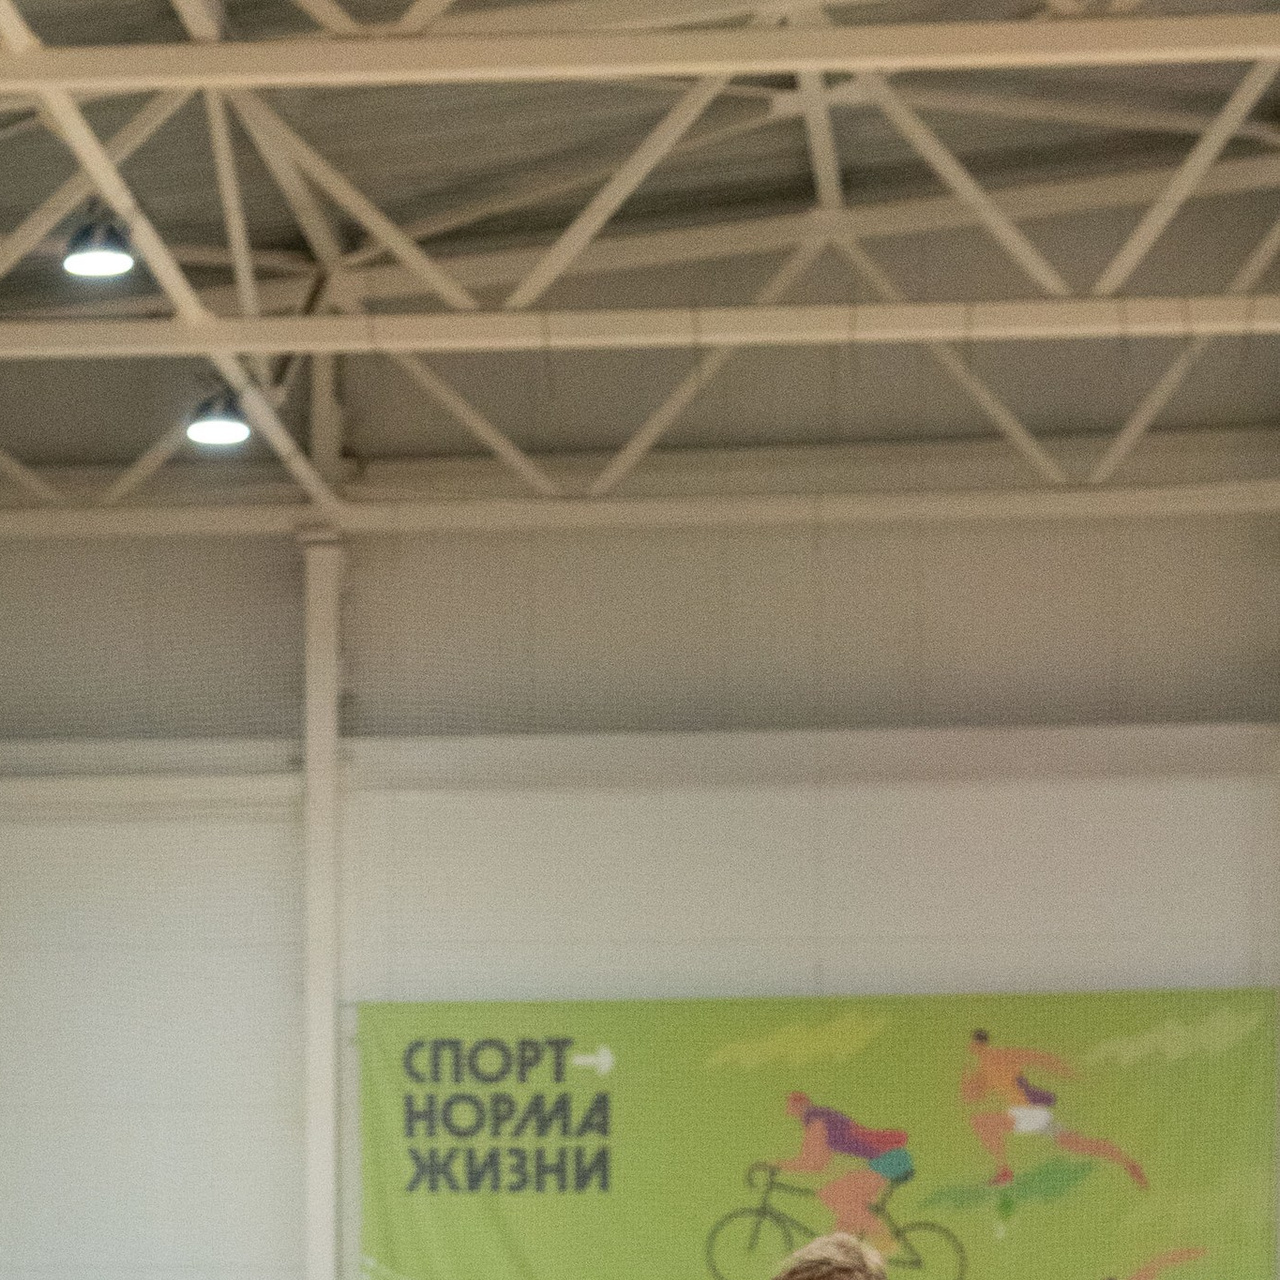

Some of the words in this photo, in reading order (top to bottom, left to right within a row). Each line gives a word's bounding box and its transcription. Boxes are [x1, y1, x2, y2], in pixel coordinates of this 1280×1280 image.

[404, 1036, 574, 1084] СПОРТ
[405, 1092, 610, 1138] НОРМА
[406, 1147, 609, 1192] ЖИЗНИ
